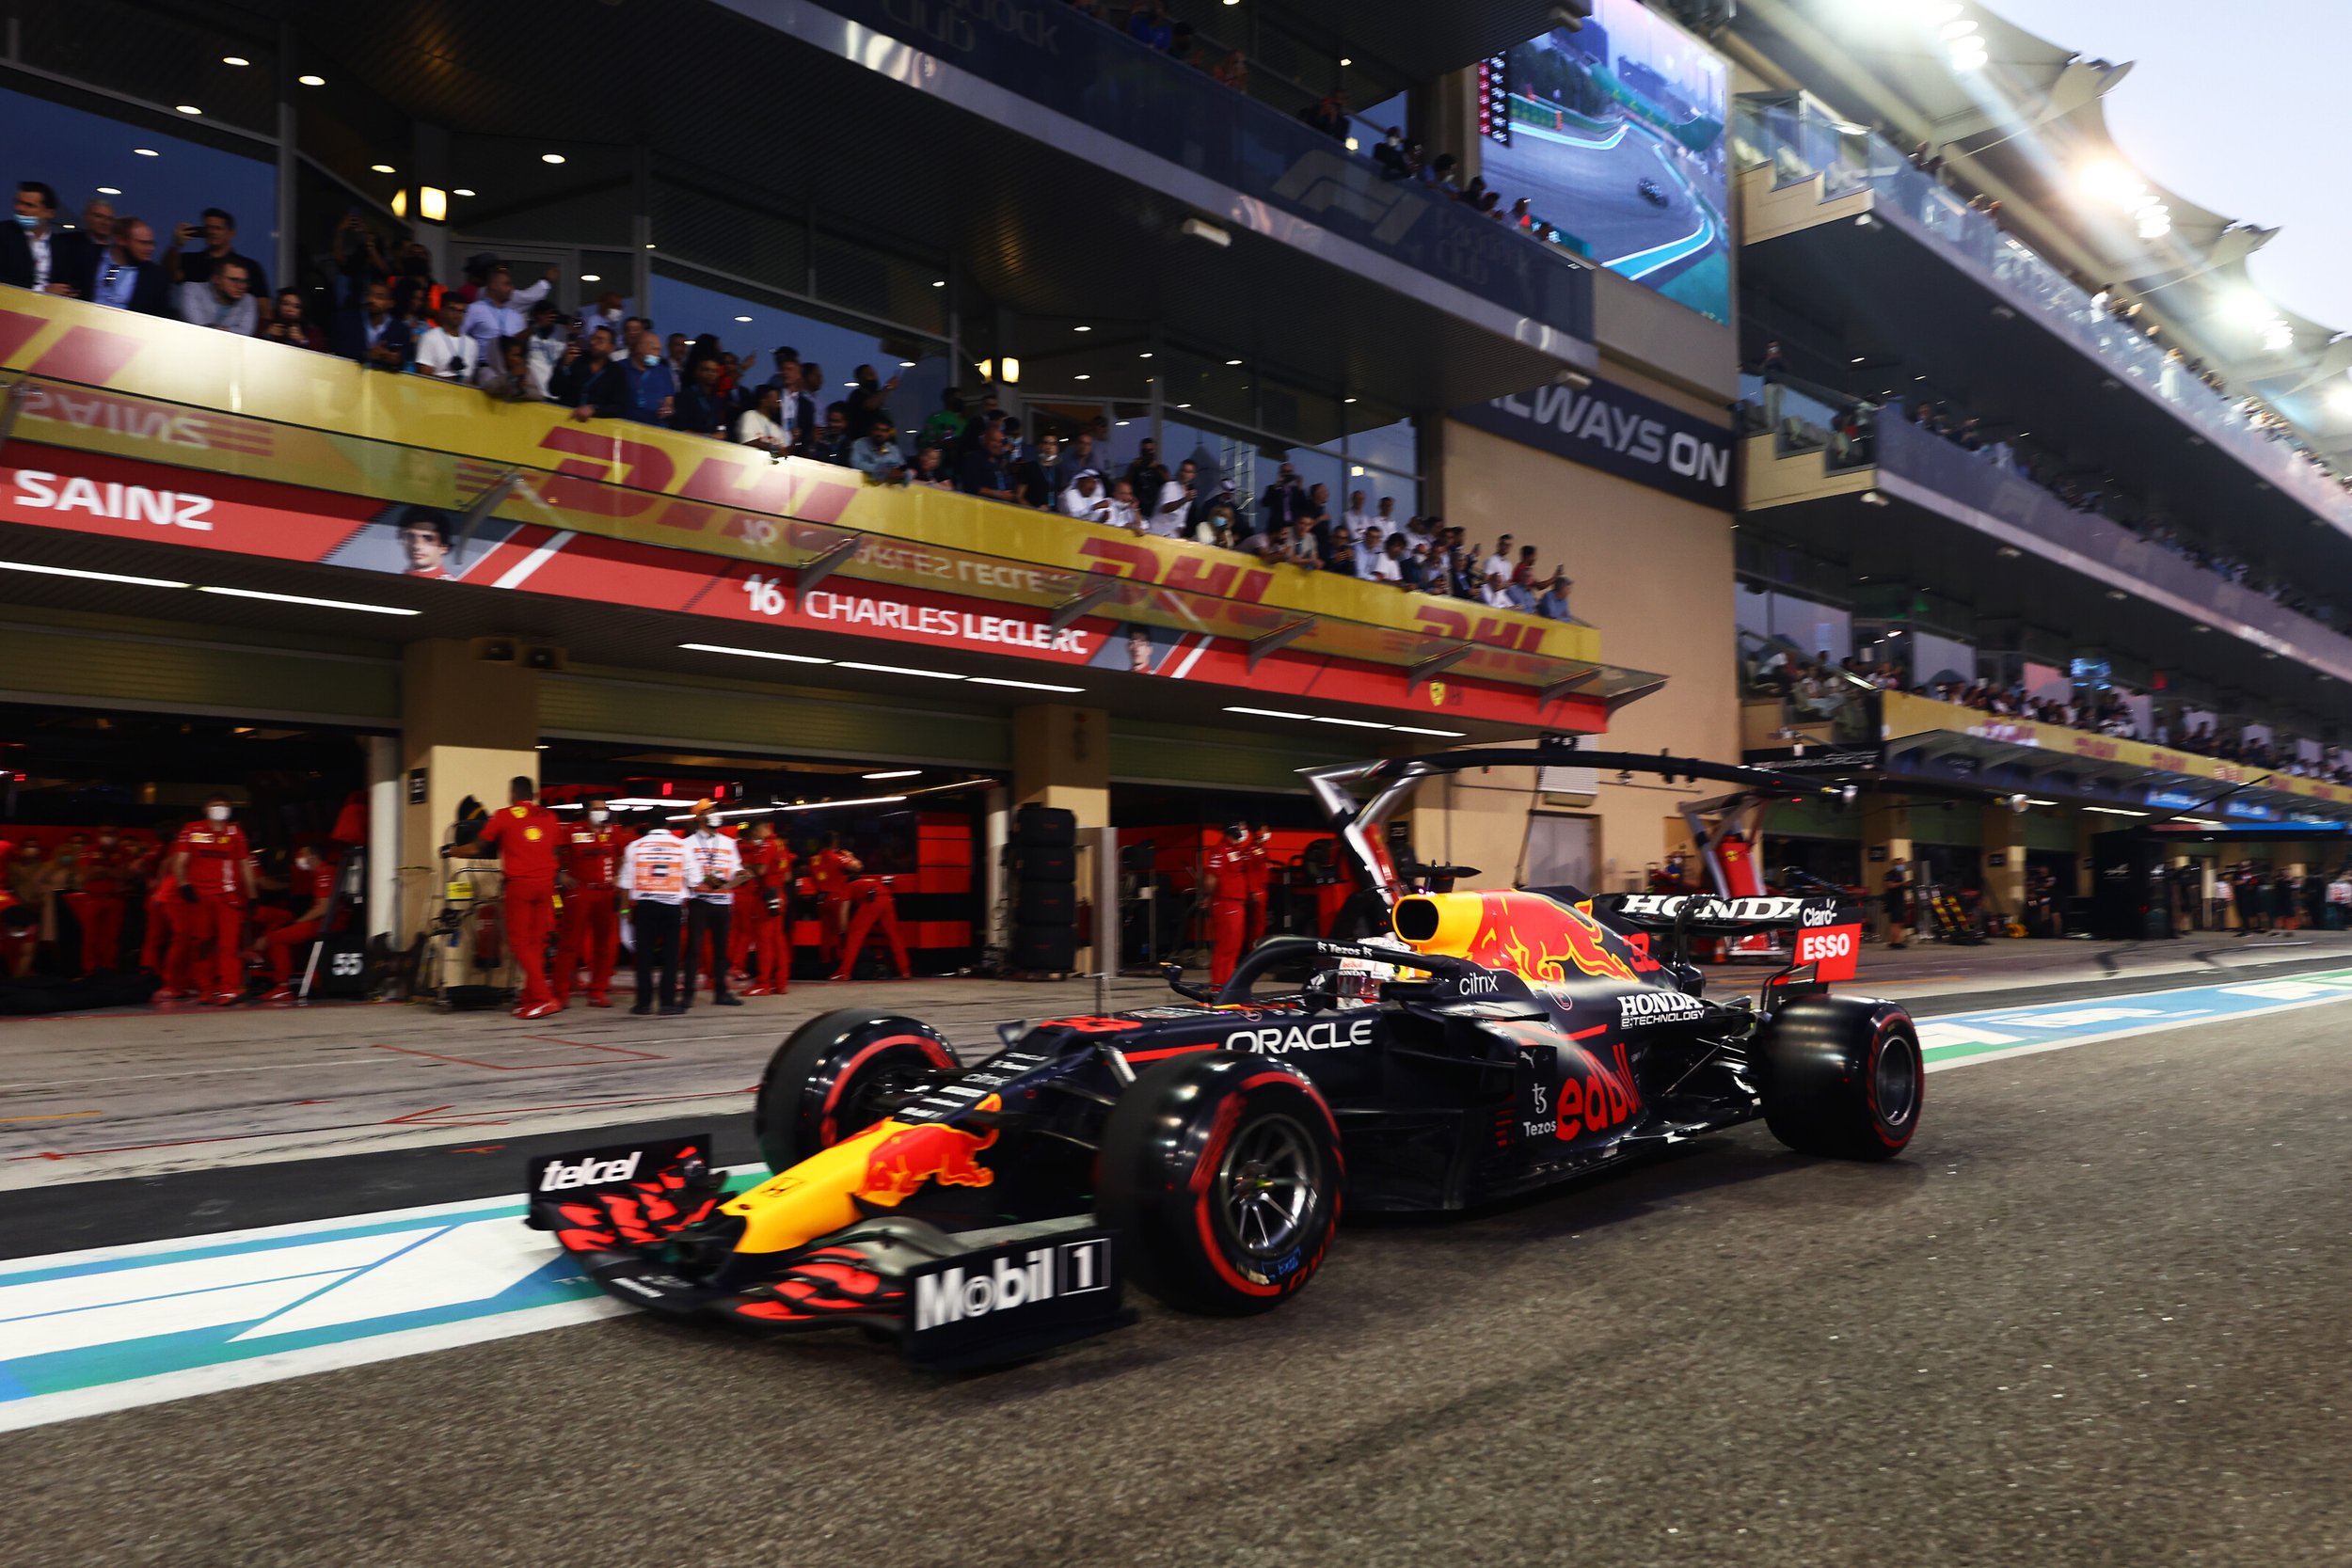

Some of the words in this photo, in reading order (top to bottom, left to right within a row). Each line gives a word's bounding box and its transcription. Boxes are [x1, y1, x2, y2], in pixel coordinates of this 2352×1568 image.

[1490, 386, 1667, 465] LWAYS
[1668, 431, 1730, 487] ON
[13, 469, 215, 531] SAINZ
[539, 426, 859, 551] DHL
[1078, 536, 1284, 628] DHL
[741, 574, 786, 616] 16
[804, 590, 960, 637] CHARLES
[962, 614, 1089, 656] LECLERC
[1413, 605, 1552, 673] DHL
[1803, 903, 1836, 927] Claro
[331, 951, 364, 977] 55
[1328, 943, 1360, 957] Tezos
[1803, 933, 1851, 961] ESSO
[1459, 972, 1500, 996] citrix
[1617, 992, 1704, 1017] HONDA
[1226, 1020, 1373, 1054] ORACLE
[1523, 1120, 1557, 1137] Tezos
[539, 1151, 643, 1192] telcel
[915, 1247, 1055, 1332] Mobil
[1073, 1245, 1094, 1289] 1
